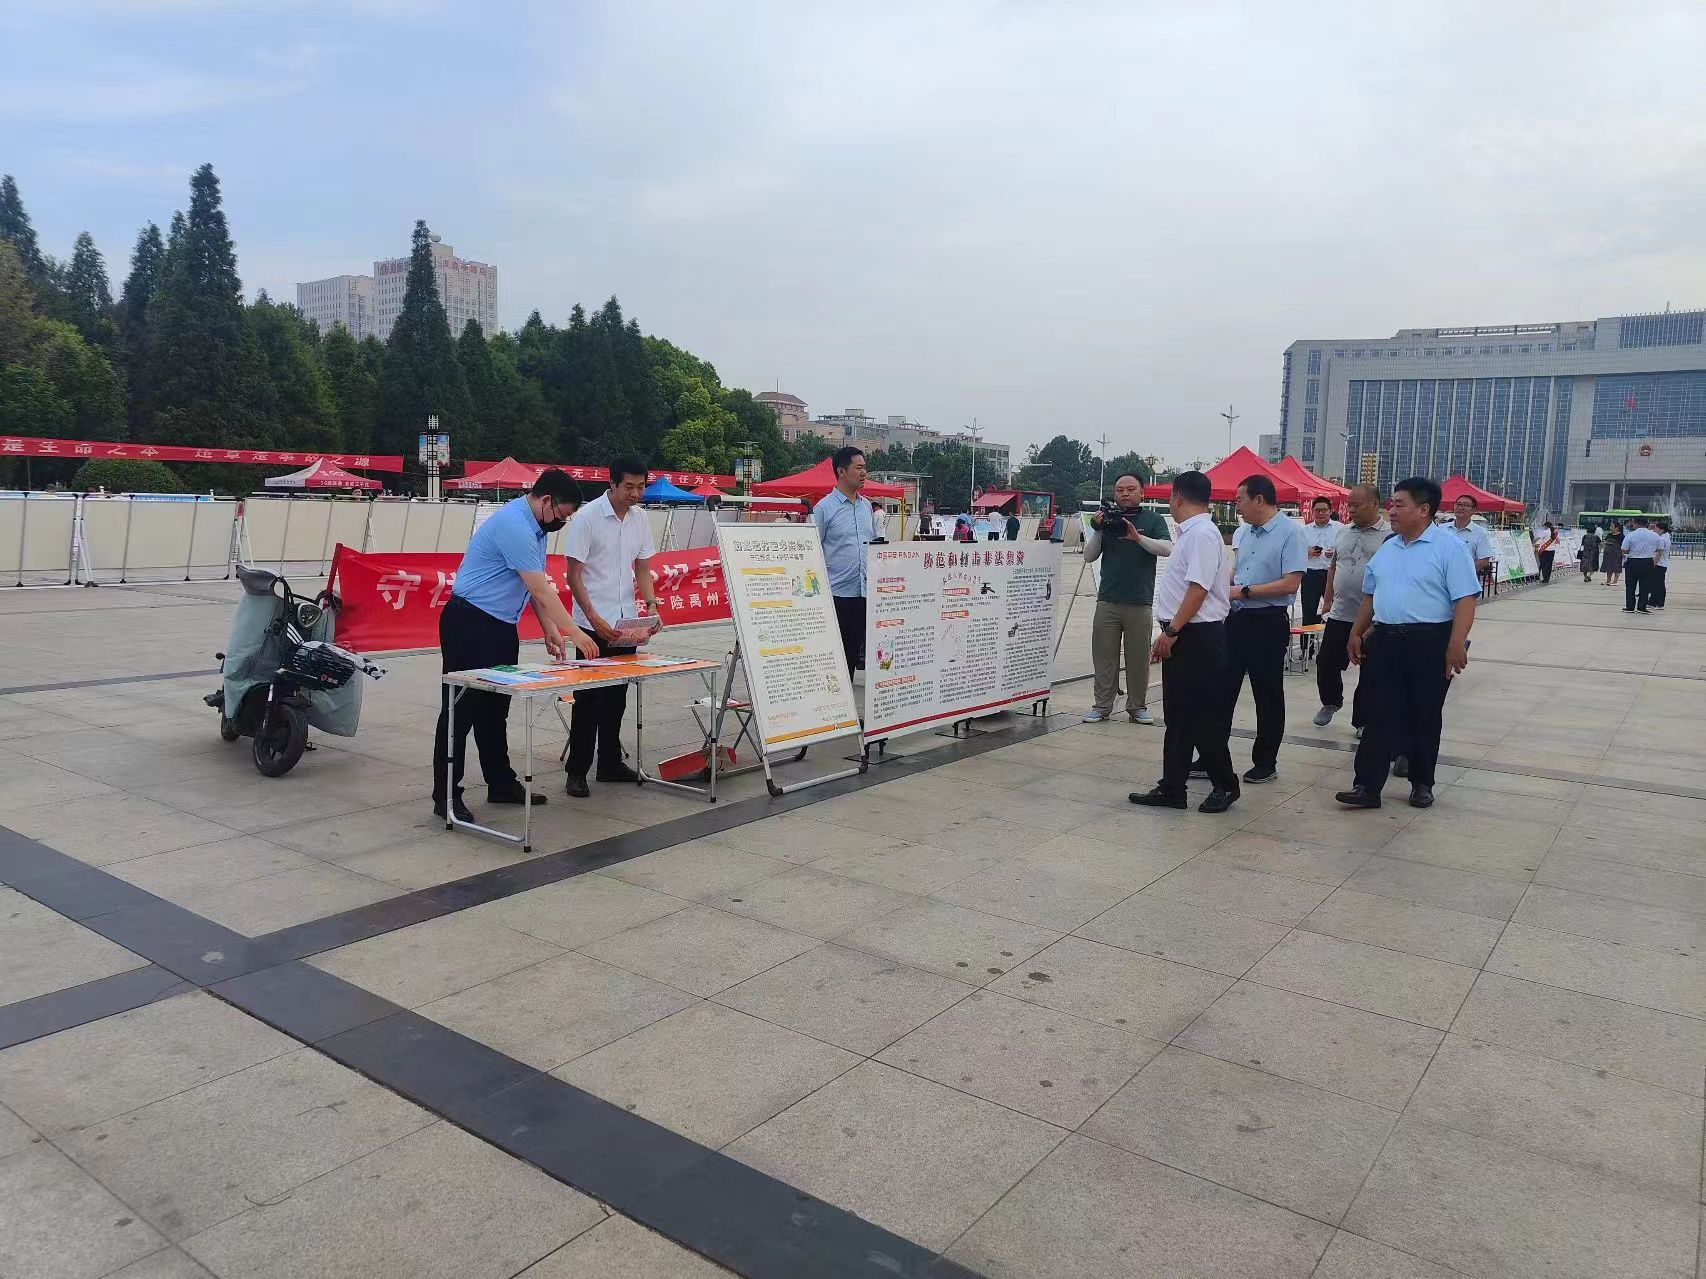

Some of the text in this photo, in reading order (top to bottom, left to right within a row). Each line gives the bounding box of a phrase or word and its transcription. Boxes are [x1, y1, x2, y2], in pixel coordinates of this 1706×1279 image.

[922, 550, 1026, 570] 防范和打击非法集资
